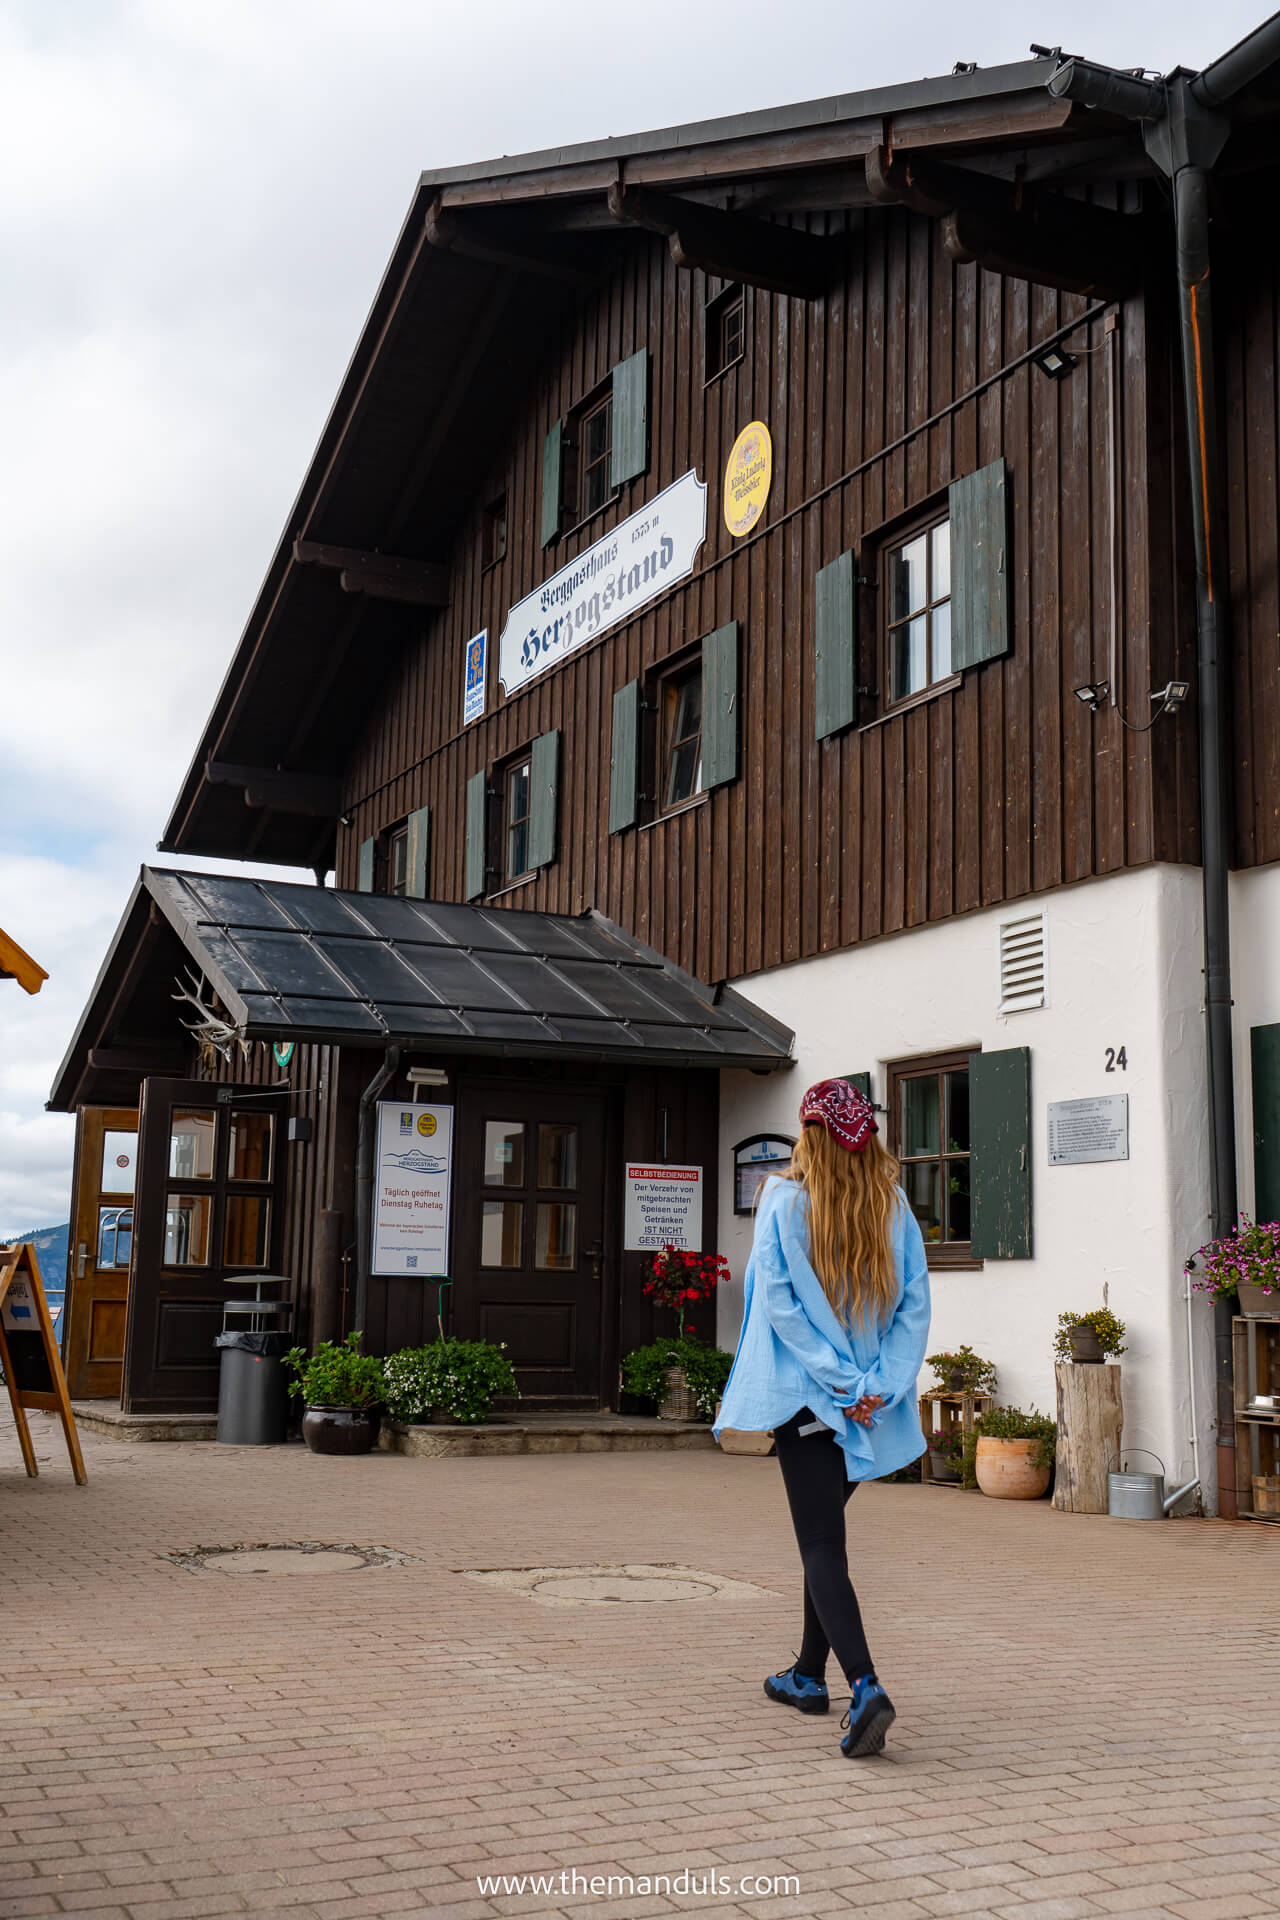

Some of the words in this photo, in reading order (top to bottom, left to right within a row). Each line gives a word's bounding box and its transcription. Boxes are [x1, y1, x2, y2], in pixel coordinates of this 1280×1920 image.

[541, 538, 618, 613] Berggasthaus
[521, 532, 674, 674] Herzogstand
[1105, 1046, 1128, 1073] 24
[399, 1160, 440, 1168] HERZOGSTAND
[629, 1169, 698, 1180] SELBSTBEDIENUNG
[384, 1187, 410, 1198] Täglich
[411, 1189, 441, 1198] geöffnet
[634, 1183, 649, 1191] Der
[649, 1184, 679, 1193] Verzehr
[637, 1195, 692, 1204] mitgebrachten
[381, 1199, 413, 1210] Dienstag
[414, 1200, 444, 1211] Ruhetag
[641, 1204, 672, 1214] Speisen
[673, 1206, 688, 1214] und
[644, 1215, 684, 1225] Getränken
[644, 1226, 657, 1234] IST
[659, 1226, 684, 1235] NICHT
[638, 1236, 688, 1246] GESTATTET!
